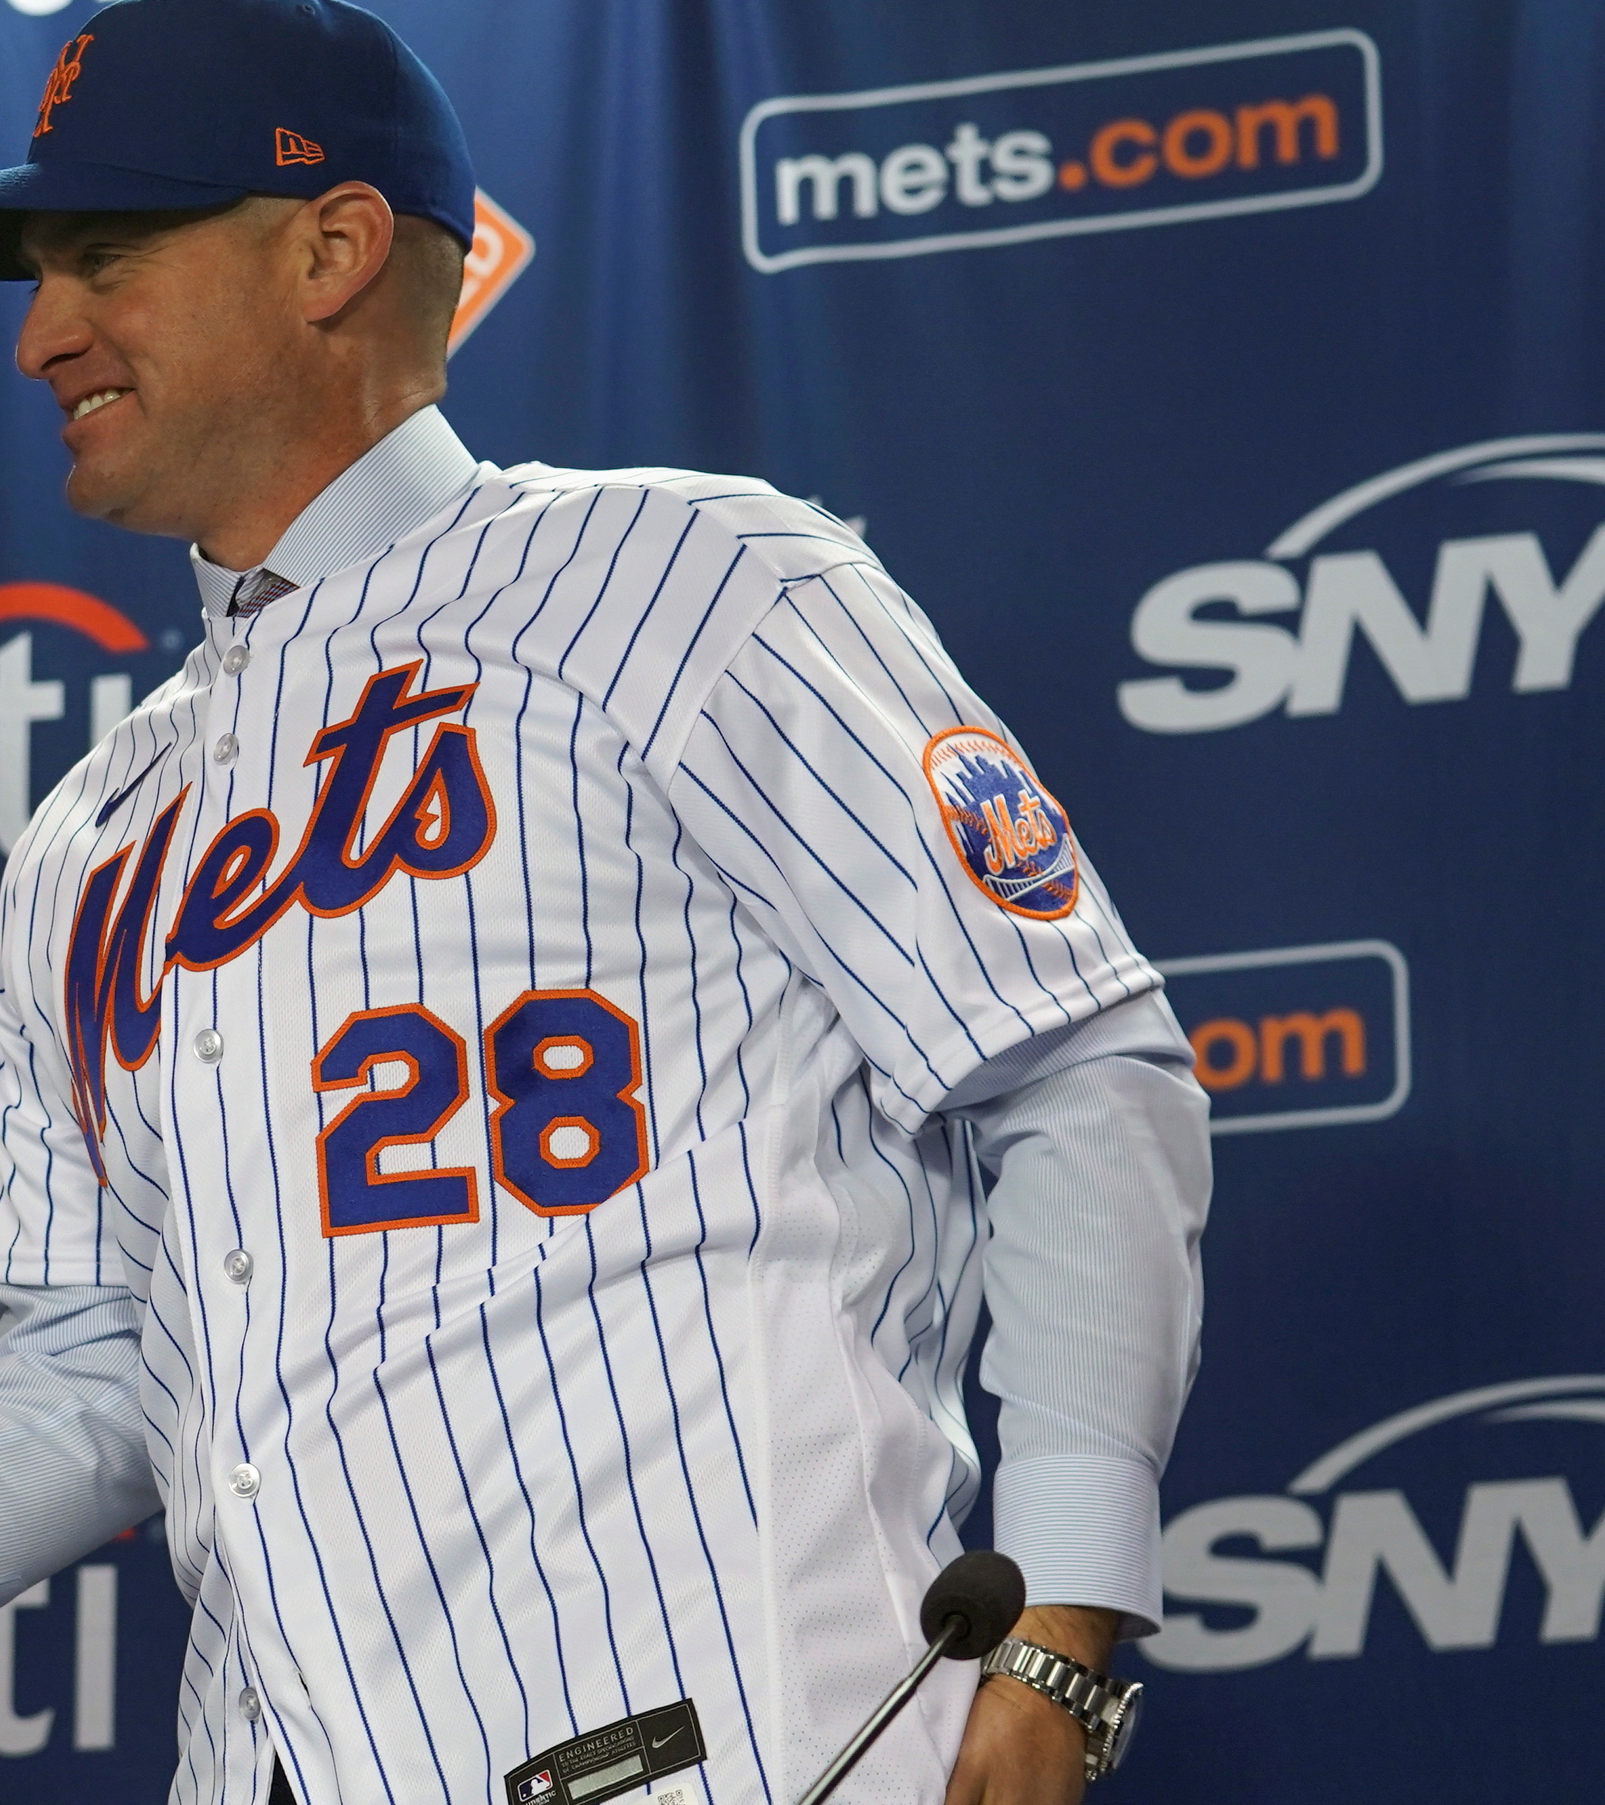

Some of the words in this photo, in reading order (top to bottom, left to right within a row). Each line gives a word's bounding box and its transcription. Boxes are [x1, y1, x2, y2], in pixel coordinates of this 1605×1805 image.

[774, 93, 1339, 226] mets.com
[1116, 521, 1605, 734] SNY
[64, 658, 497, 1188] Mets
[979, 789, 1057, 876] Mets
[311, 988, 649, 1238] 28
[1136, 1476, 1605, 1674] SNY
[558, 1726, 634, 1762] ENGINEERED
